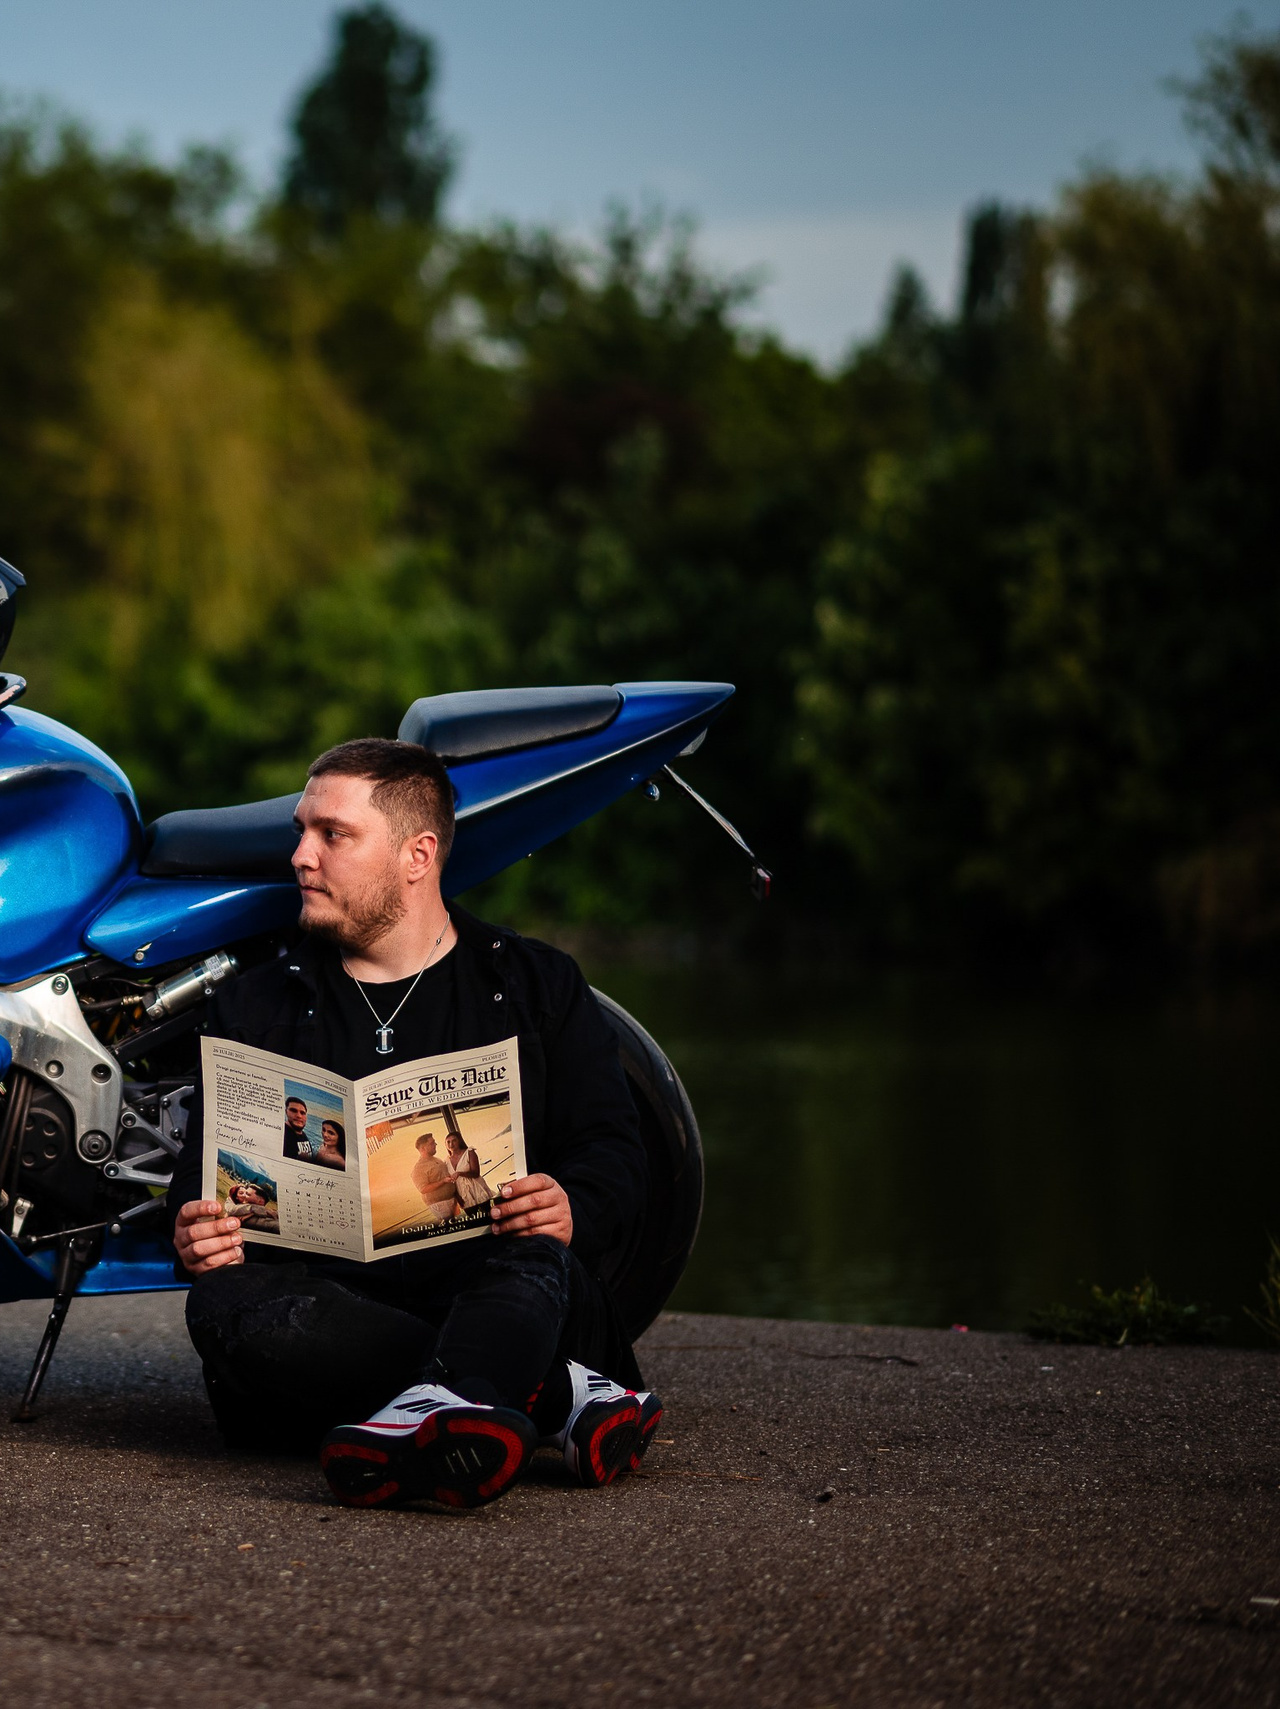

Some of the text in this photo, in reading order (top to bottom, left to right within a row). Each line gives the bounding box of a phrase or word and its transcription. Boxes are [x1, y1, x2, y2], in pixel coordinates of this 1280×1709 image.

[365, 1065, 507, 1115] Save The Date
[384, 1085, 489, 1116] FOR THE WEDDING OF
[401, 1223, 435, 1235] Ioana
